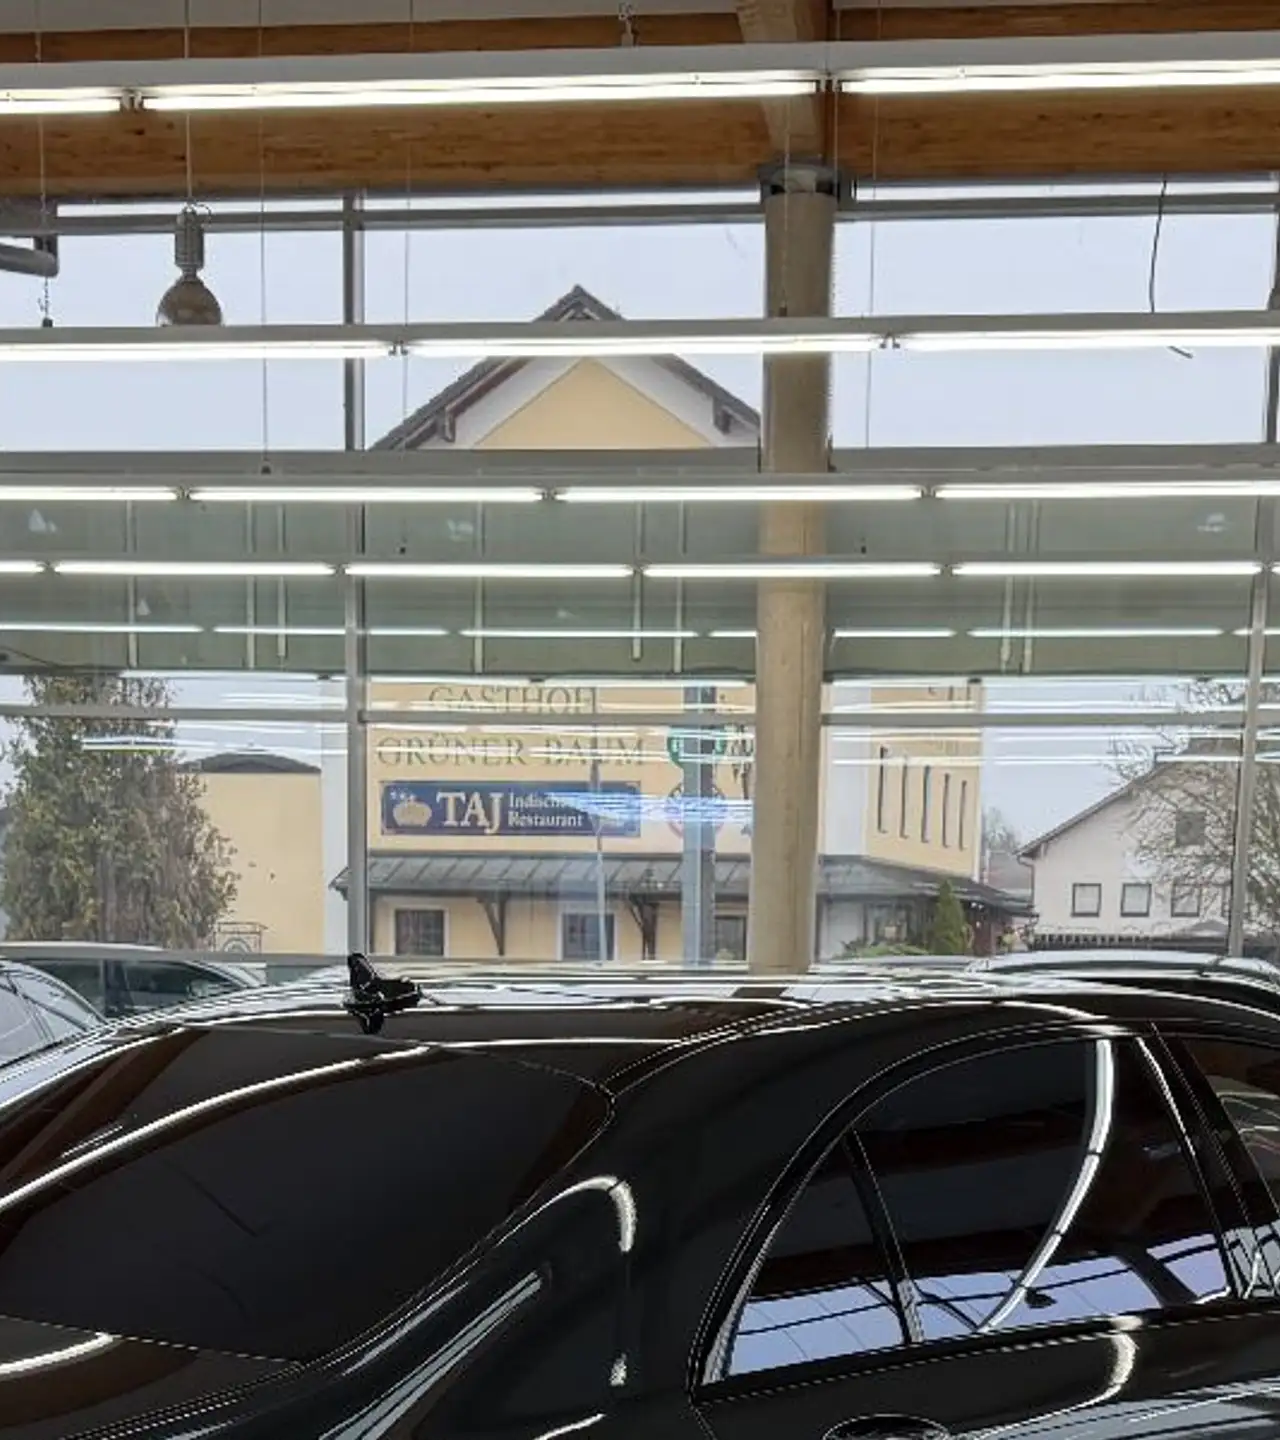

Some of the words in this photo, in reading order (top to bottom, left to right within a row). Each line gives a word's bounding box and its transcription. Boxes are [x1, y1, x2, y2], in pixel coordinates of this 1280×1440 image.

[429, 686, 596, 714] GASTHOF
[377, 731, 527, 766] GRÜNER
[545, 737, 645, 767] BAUM
[436, 791, 504, 834] TAJ
[508, 812, 583, 827] Restaurant
